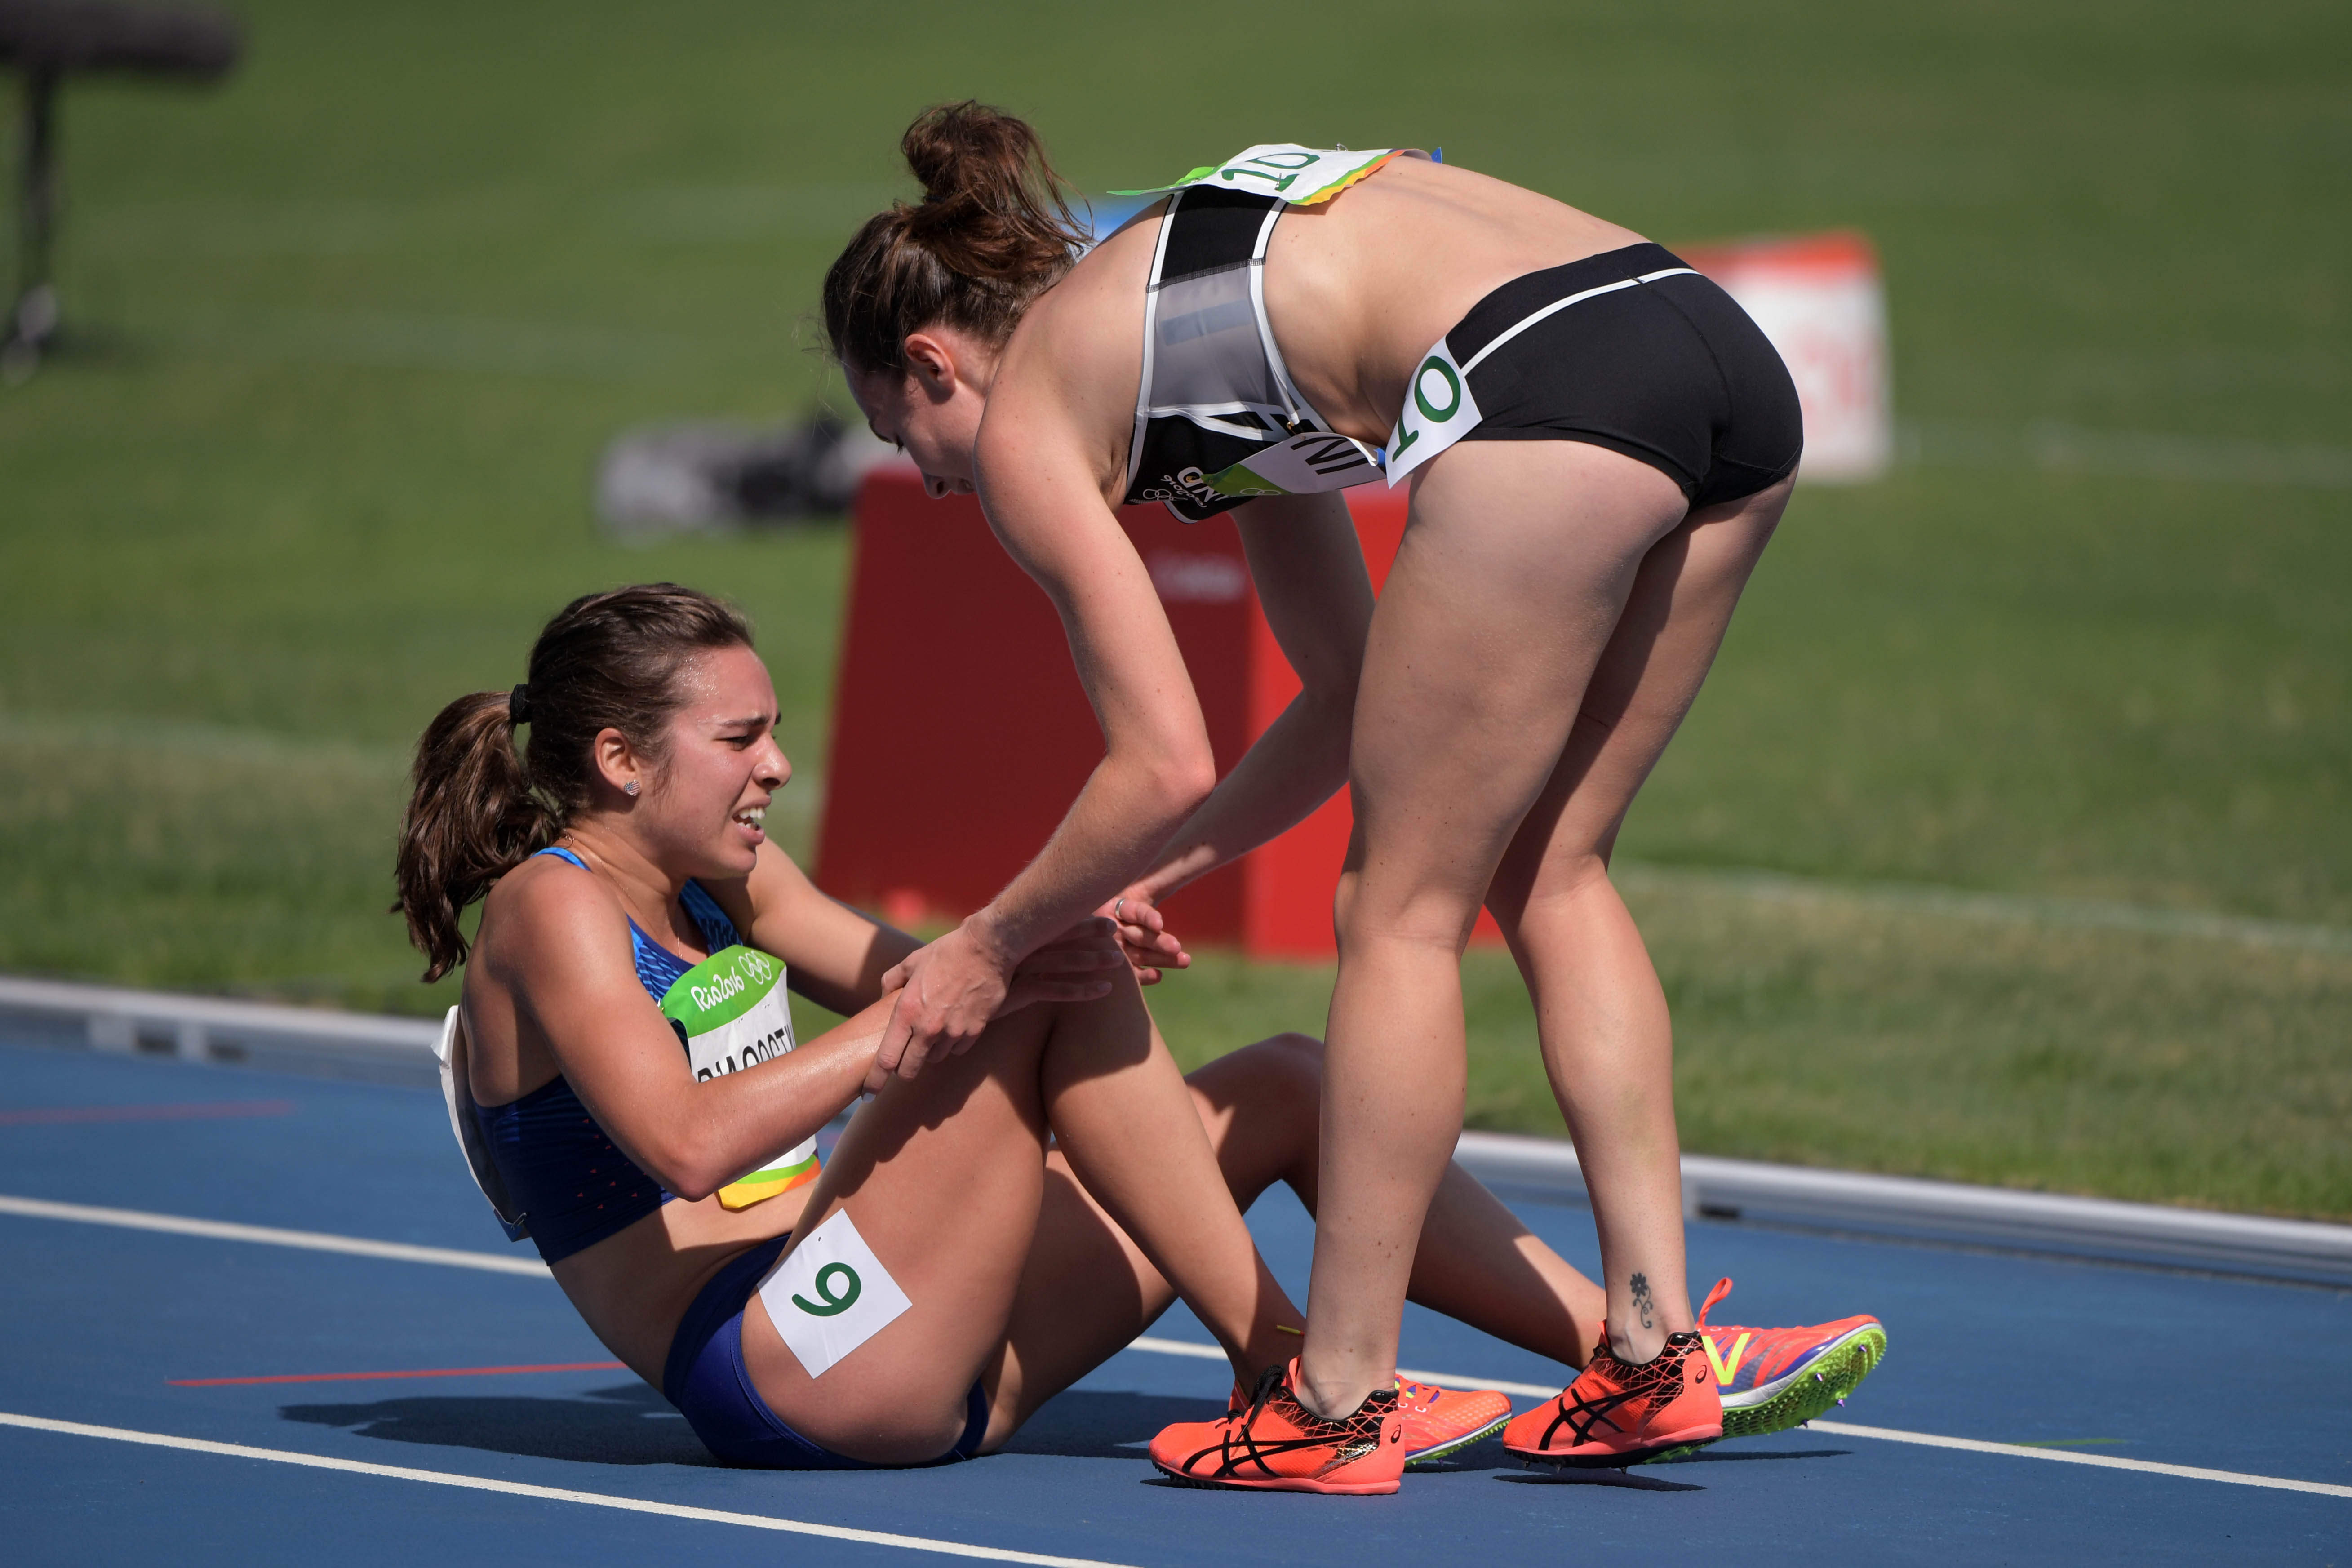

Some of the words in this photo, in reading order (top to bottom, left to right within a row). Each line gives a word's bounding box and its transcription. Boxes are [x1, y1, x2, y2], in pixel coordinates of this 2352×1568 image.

[1221, 152, 1321, 192] 10
[1392, 355, 1461, 463] 10
[690, 966, 745, 1012] Rio2016
